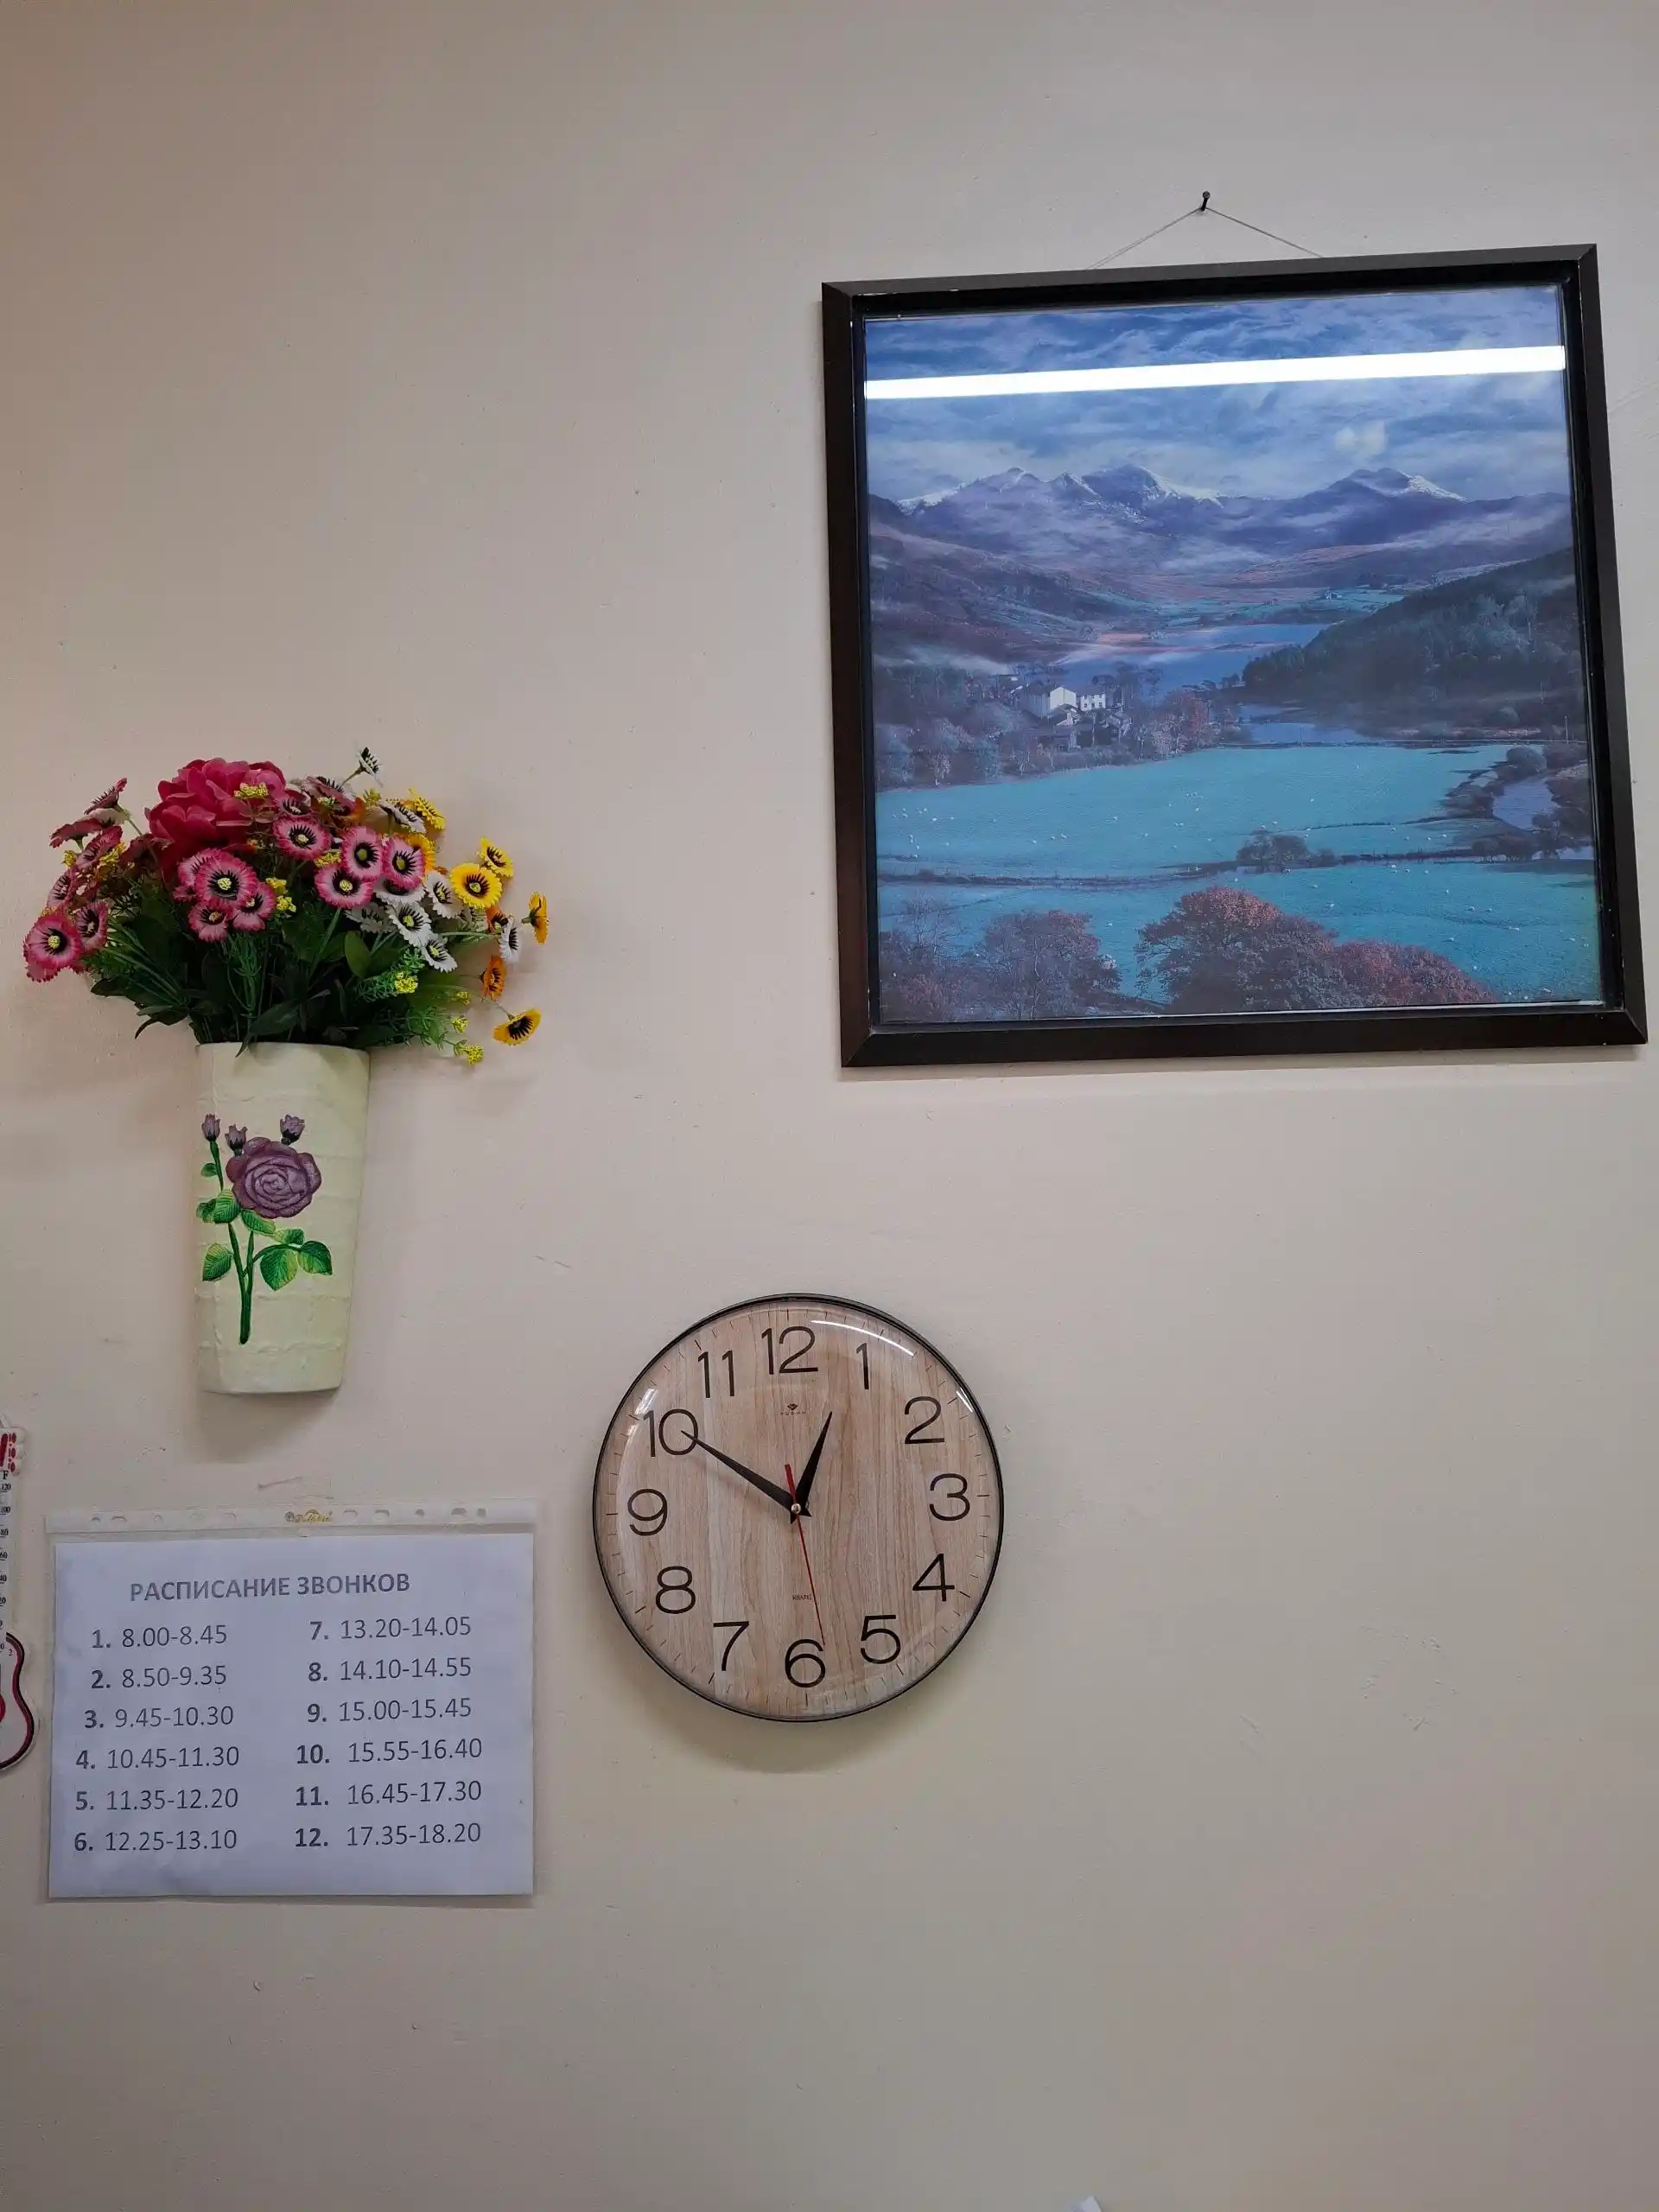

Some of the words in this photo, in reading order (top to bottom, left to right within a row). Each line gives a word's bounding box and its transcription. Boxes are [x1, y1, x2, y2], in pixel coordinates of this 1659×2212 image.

[761, 1325, 819, 1376] 12
[697, 1351, 734, 1398] 11
[856, 1343, 870, 1390] 1
[643, 1408, 699, 1458] 10
[905, 1396, 945, 1445] 2
[929, 1472, 970, 1522] 3
[627, 1488, 668, 1537] 9
[130, 1577, 290, 1602] РАСПИСАНИЕ
[297, 1573, 410, 1595] ЗВОНКОВ
[654, 1565, 696, 1615] 8
[912, 1553, 956, 1603] 4
[92, 1629, 111, 1649] 1.
[122, 1624, 227, 1648] 8.00-8.45
[309, 1620, 329, 1641] 7.
[340, 1616, 471, 1639] 13.20-14.05
[860, 1614, 901, 1664] 5
[713, 1620, 750, 1672] 7
[91, 1669, 111, 1689] 2.
[122, 1665, 227, 1688] 8.50-9.35
[308, 1662, 328, 1682] 8.
[340, 1656, 471, 1681] 14.10-14.55
[784, 1638, 826, 1688] 6
[84, 1709, 105, 1729] 3.
[115, 1705, 234, 1728] 9.45-10.30
[307, 1703, 327, 1723] 9.
[339, 1697, 472, 1722] 15.00-15.45
[75, 1750, 96, 1770] 4.
[108, 1745, 239, 1769] 10.45-11.30
[296, 1744, 330, 1764] 10.
[348, 1738, 482, 1763] 15.55-16.40
[75, 1790, 94, 1811] 5.
[107, 1788, 238, 1810] 11.35-12.20
[296, 1785, 329, 1807] 11.
[347, 1780, 482, 1805] 16.45-17.30
[74, 1832, 93, 1852] 6.
[105, 1829, 237, 1851] 12.25-13.10
[295, 1827, 328, 1847] 12.
[347, 1822, 481, 1847] 17.35-18.20
